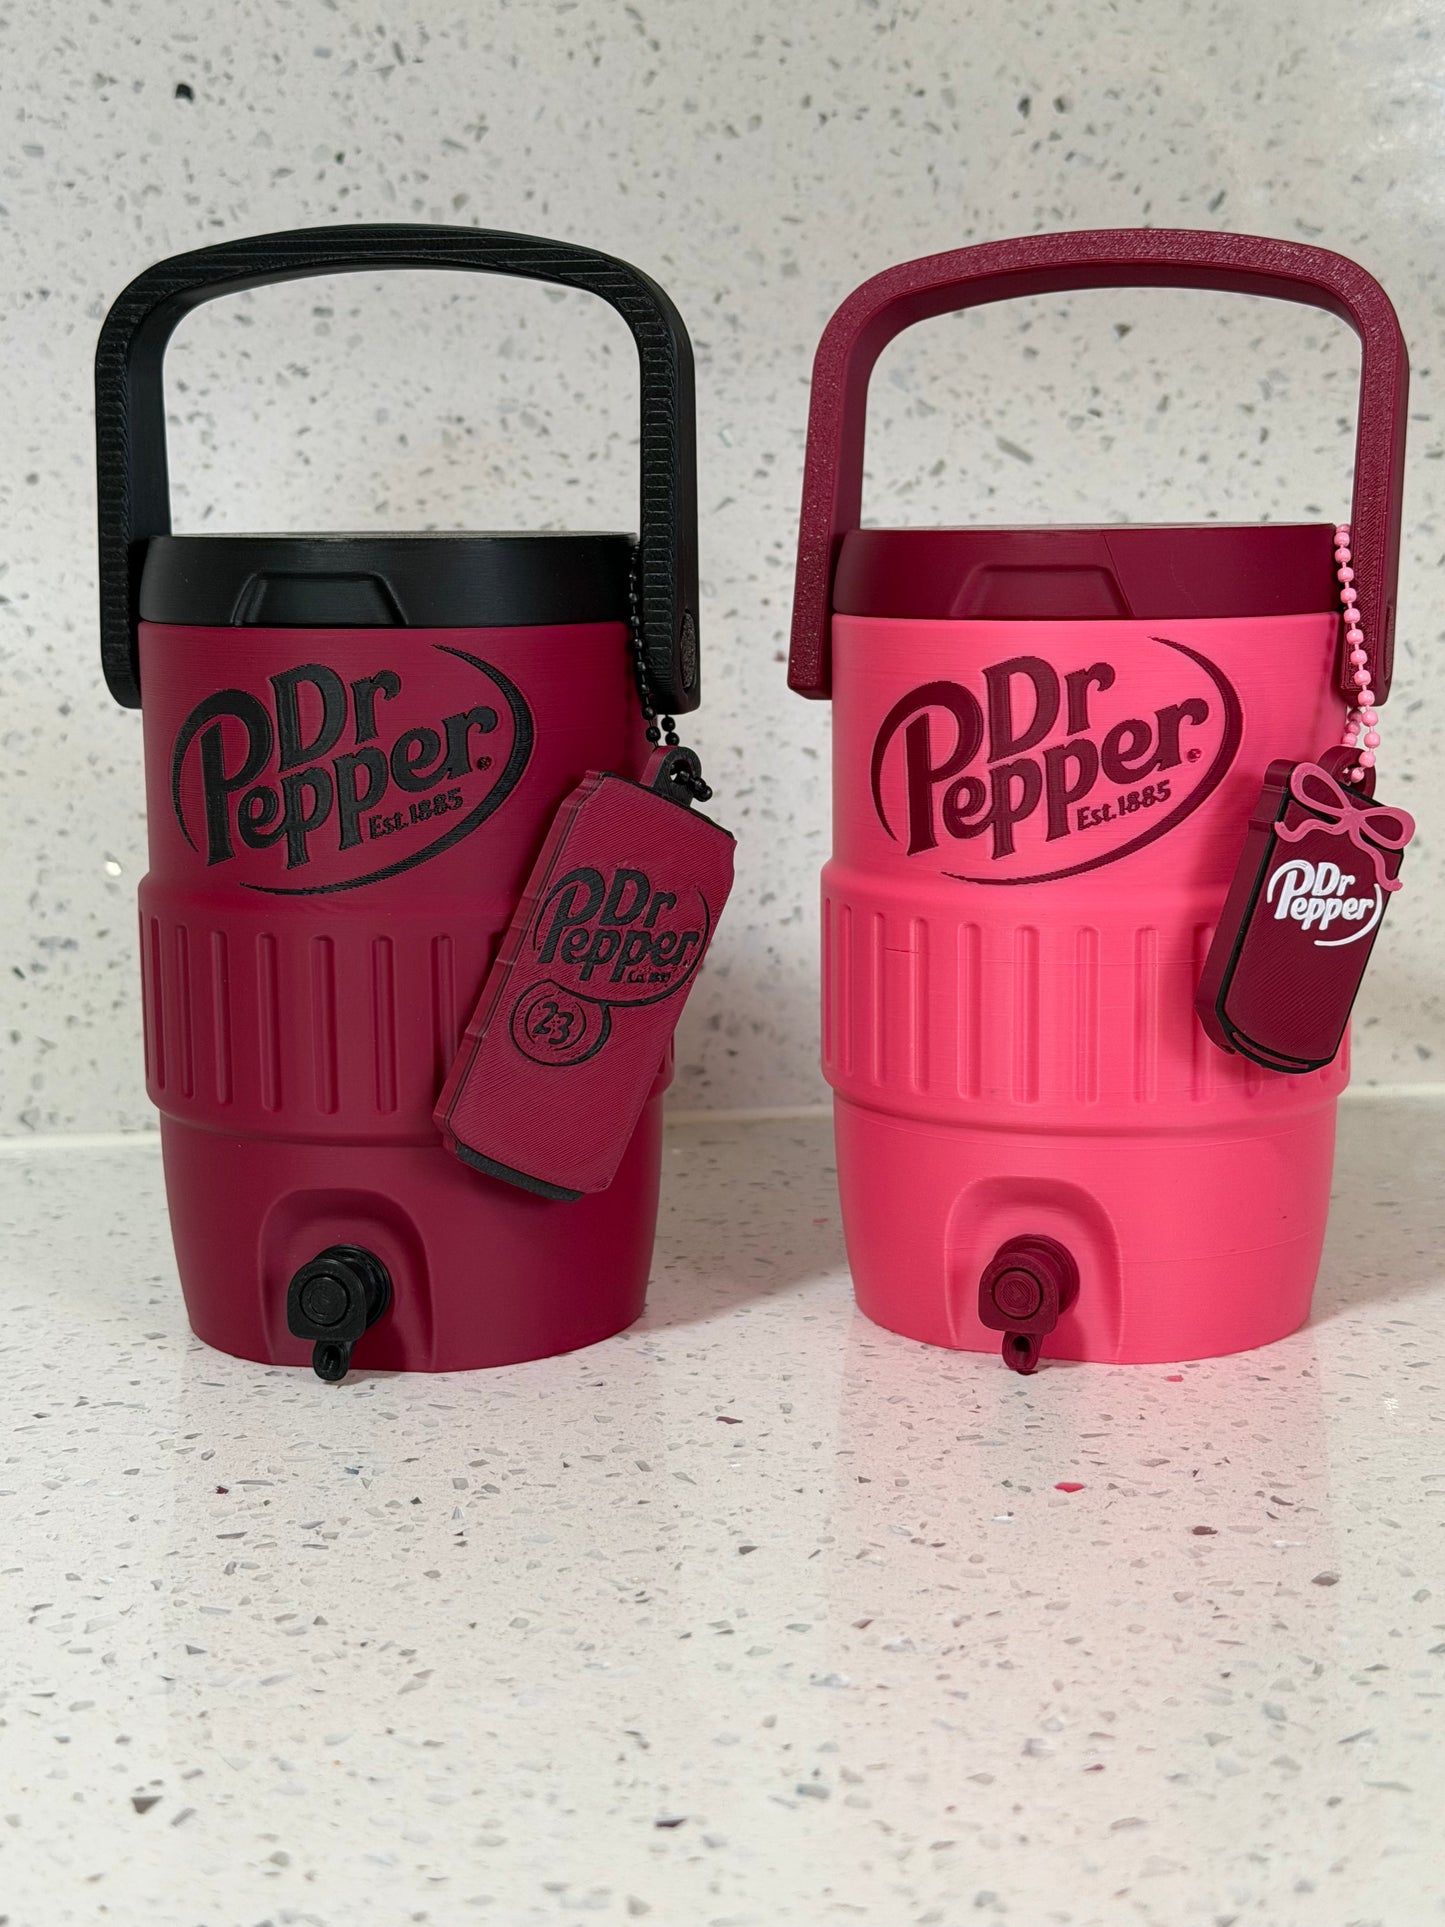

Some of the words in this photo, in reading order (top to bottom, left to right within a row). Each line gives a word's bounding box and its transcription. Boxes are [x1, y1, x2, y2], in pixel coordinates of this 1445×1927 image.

[269, 663, 402, 772] Dr
[981, 655, 1116, 764] Dr
[171, 688, 499, 870] Pepper
[870, 680, 1210, 860] Pepper
[1076, 803, 1117, 831] Est.
[1117, 778, 1172, 816] 1885
[368, 811, 409, 840] Est.
[409, 786, 464, 824] 1885
[599, 868, 678, 929] Dr
[1266, 859, 1375, 931] Pepper
[1311, 861, 1356, 897] Dr
[533, 867, 701, 982] Pepper
[532, 1001, 575, 1046] 23
